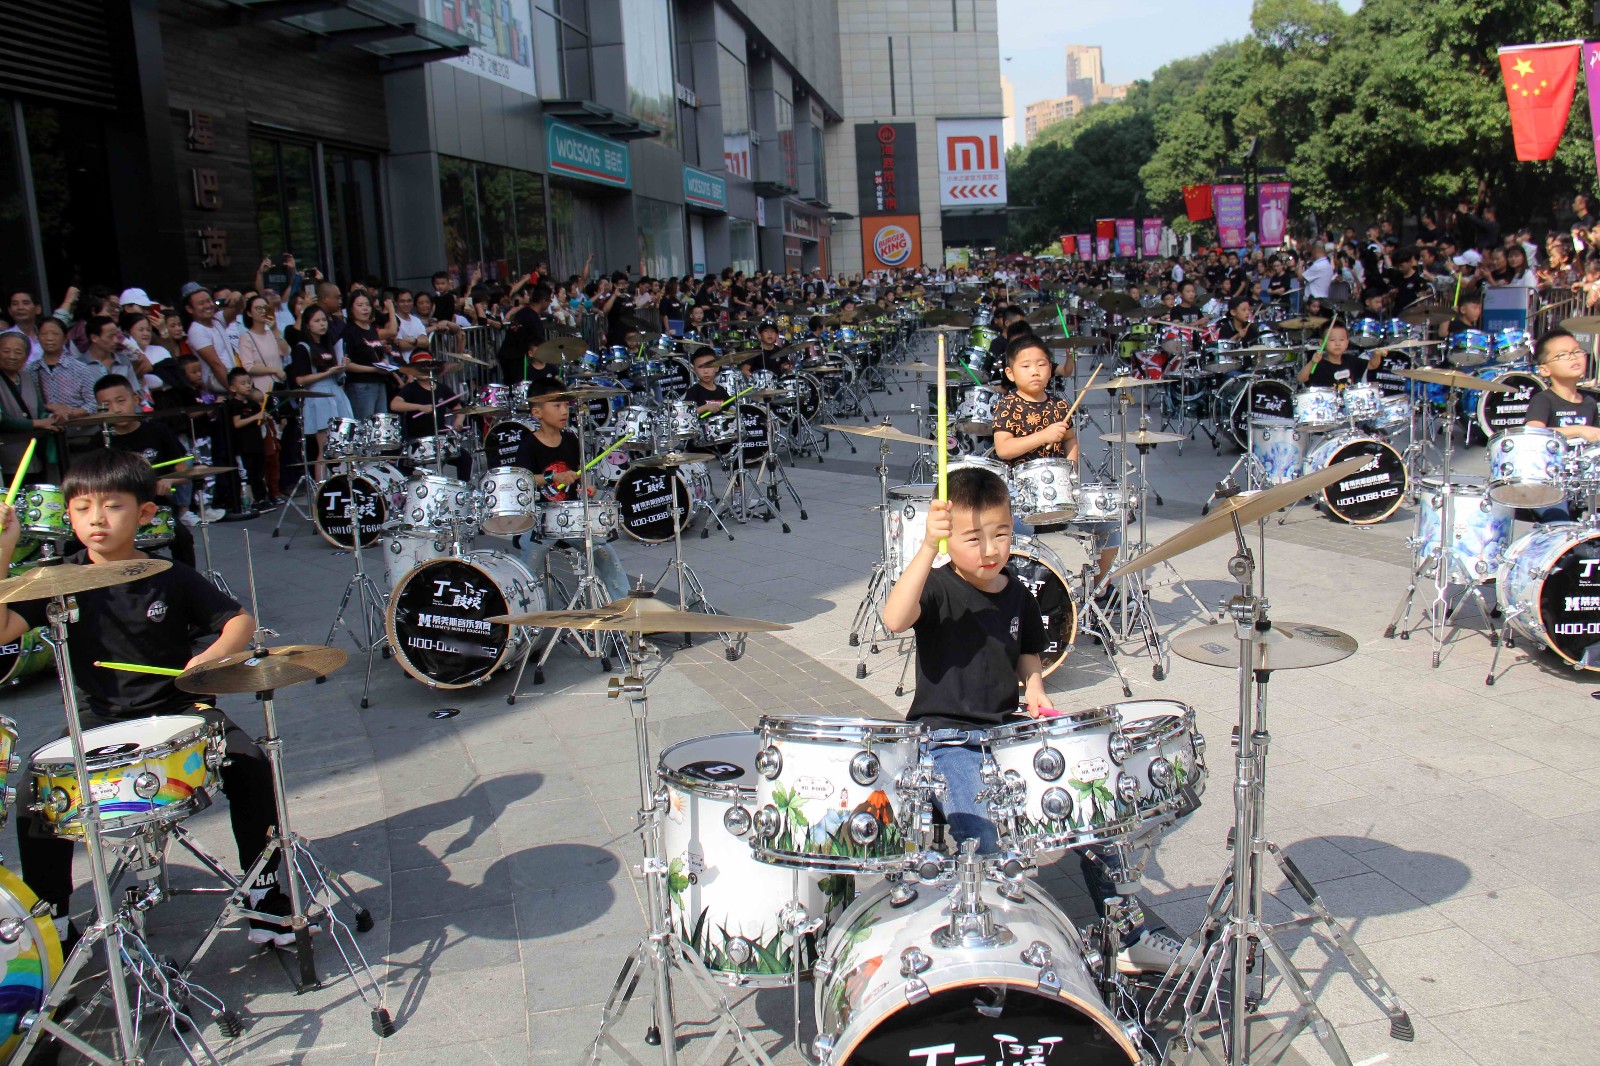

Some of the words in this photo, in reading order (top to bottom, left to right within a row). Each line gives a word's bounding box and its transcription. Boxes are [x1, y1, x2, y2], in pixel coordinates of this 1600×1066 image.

[556, 136, 600, 167] watsons
[188, 109, 231, 268] 星巴克
[687, 177, 710, 196] watsons
[878, 232, 905, 248] BURGER
[880, 239, 907, 258] KING
[1336, 487, 1399, 506] 400-0088-052
